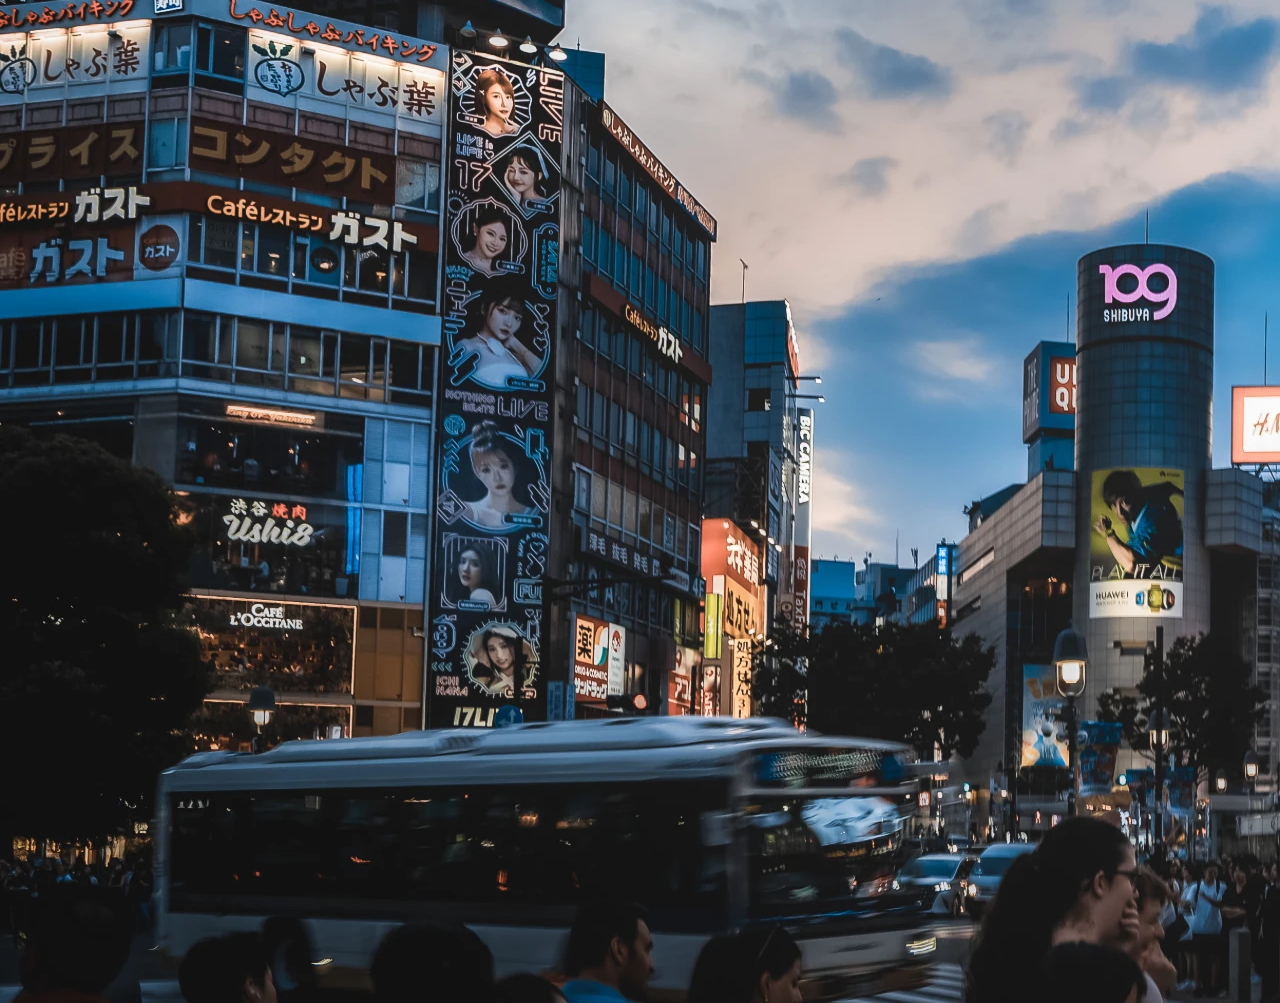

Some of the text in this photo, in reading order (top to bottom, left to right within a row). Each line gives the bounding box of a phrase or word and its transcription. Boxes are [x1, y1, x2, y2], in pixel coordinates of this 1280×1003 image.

[44, 39, 140, 82] しゃぶ葉
[317, 61, 436, 117] しゃぶ葉
[193, 126, 388, 190] コンタクト
[455, 160, 492, 192] 17
[75, 187, 150, 223] ガスト
[207, 195, 418, 252] Caféレストラン ガスト
[30, 237, 124, 283] ガスト
[144, 245, 175, 258] ガスト
[1100, 263, 1177, 321] 109
[1104, 307, 1149, 322] SHIBUYA
[658, 326, 683, 364] ガスト
[1056, 362, 1076, 385] U
[498, 396, 548, 421] LIVE
[1056, 386, 1076, 411] Q
[799, 415, 811, 504] BIC CAMERA
[222, 513, 314, 547] Ushi8
[1092, 563, 1180, 581] PLAY IT ALL
[1096, 590, 1129, 600] HUAWEI
[578, 624, 592, 659] 薬
[436, 686, 468, 697] NANA
[574, 678, 607, 699] サンドラッグ
